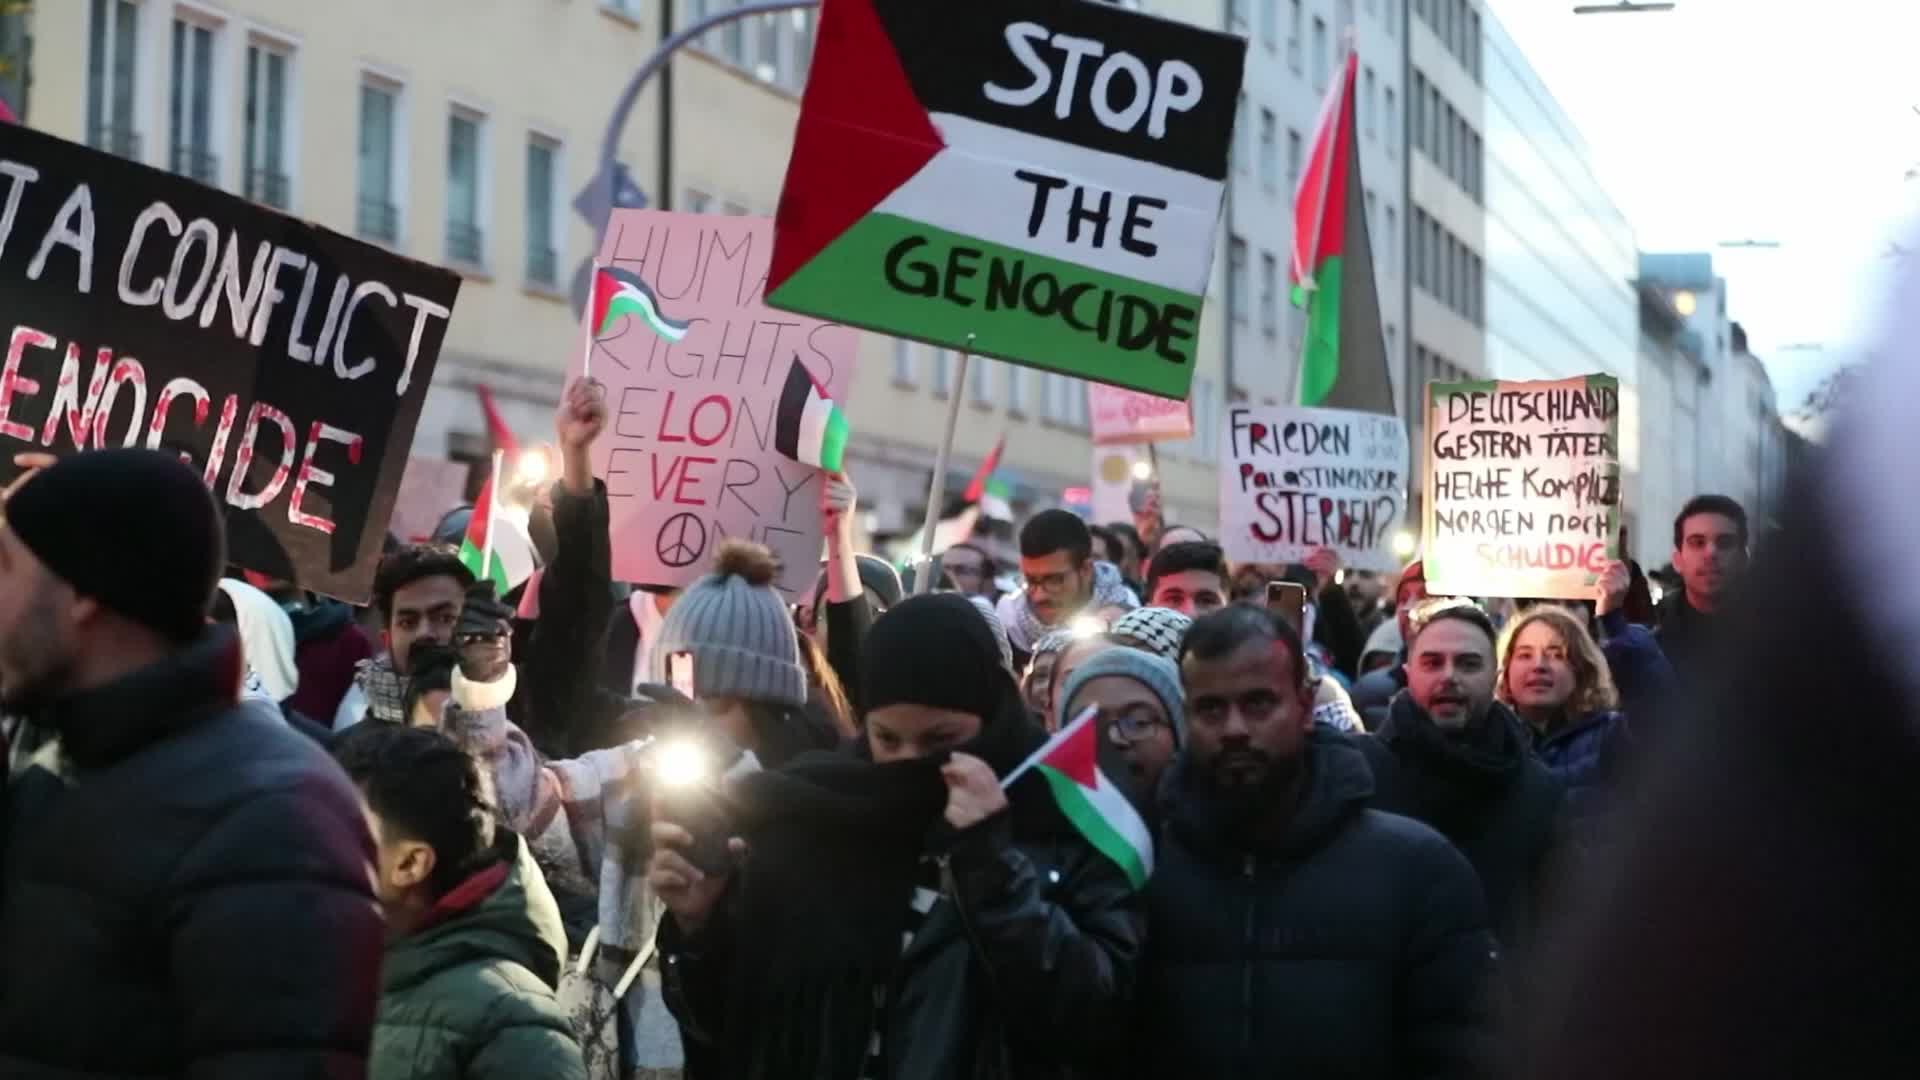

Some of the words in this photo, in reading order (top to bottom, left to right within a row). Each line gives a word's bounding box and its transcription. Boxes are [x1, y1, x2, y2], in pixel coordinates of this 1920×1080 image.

[983, 22, 1203, 139] STOP
[1015, 168, 1168, 258] THE
[27, 183, 96, 293] A
[118, 202, 451, 397] CONFLICT
[611, 223, 767, 307] HUM
[884, 235, 1196, 364] GENOCIDE
[1434, 430, 1532, 461] GESTERN
[1539, 426, 1616, 458] TÄTER
[1449, 386, 1618, 425] DEUTSCHLAND
[606, 447, 815, 522] EVERY
[1250, 490, 1397, 552] STERBEN?
[1476, 541, 1605, 573] SCHULDIG
